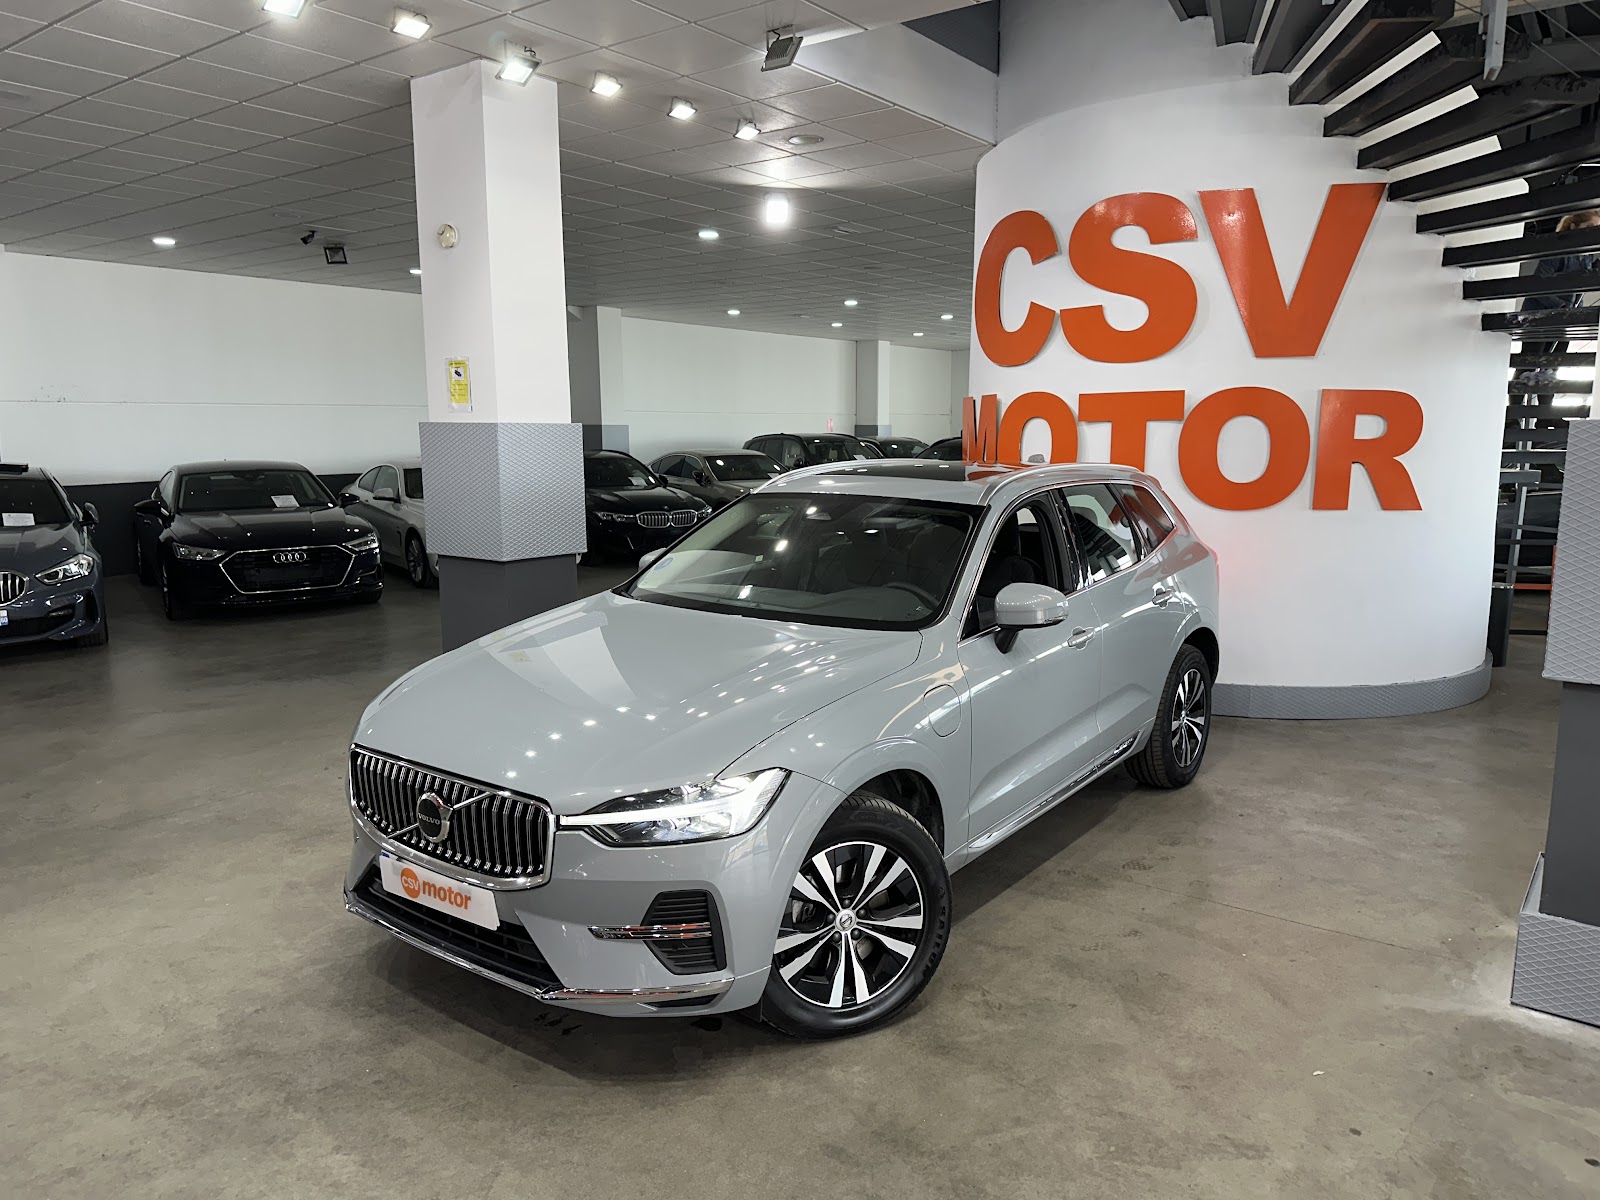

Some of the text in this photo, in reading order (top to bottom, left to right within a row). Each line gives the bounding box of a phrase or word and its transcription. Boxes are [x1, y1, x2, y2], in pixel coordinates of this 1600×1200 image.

[974, 182, 1388, 367] CSV
[962, 386, 1424, 511] MOTOR
[418, 813, 441, 825] VOLVO
[401, 876, 471, 910] CSV motor
